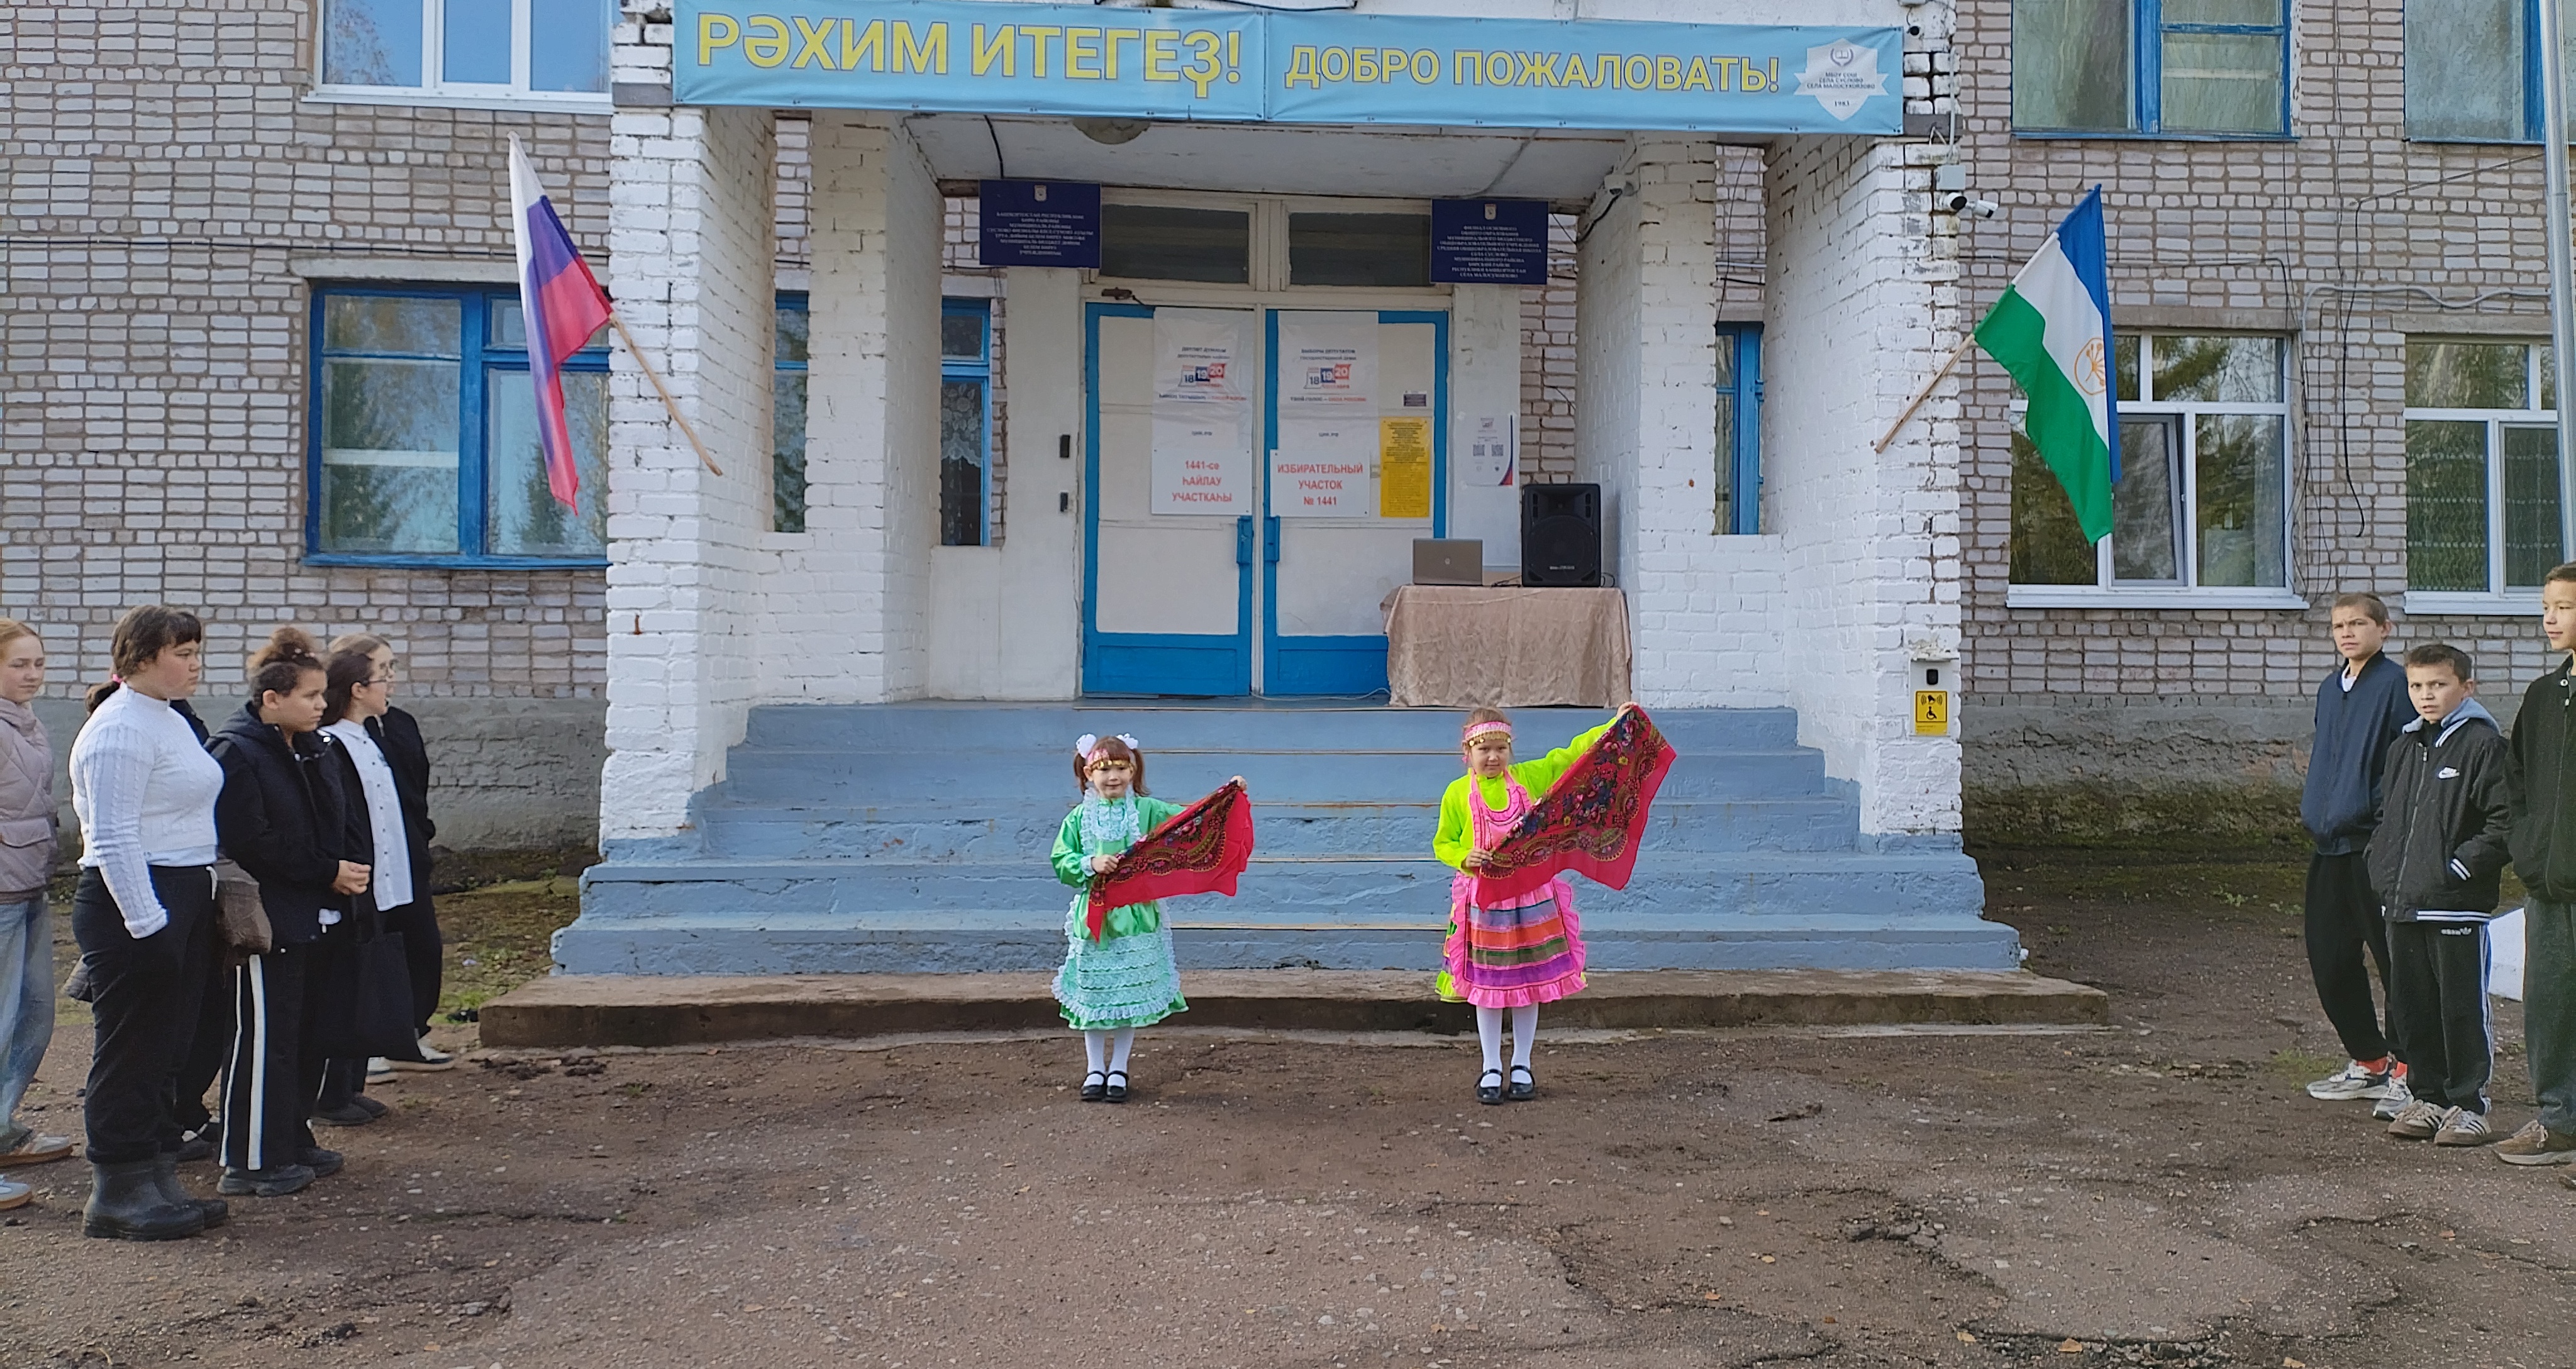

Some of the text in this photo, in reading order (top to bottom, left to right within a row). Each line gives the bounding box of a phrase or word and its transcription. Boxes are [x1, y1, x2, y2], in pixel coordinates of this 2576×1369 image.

[697, 13, 1241, 98] РӘХИМ ИТЕГЕҘ!
[1284, 45, 1780, 93] ДОБРО ПОЖАЛОВАТЬ!
[1210, 367, 1222, 376] 20
[1321, 370, 1333, 380] 19
[1335, 367, 1348, 376] 20
[1185, 375, 1194, 383] 18
[1309, 376, 1319, 385] 18
[1277, 462, 1363, 474] ИЗБИРАТЕЛЬНЫЙ
[1298, 480, 1343, 490] УЧАСТОК
[1304, 496, 1337, 506] № 1441
